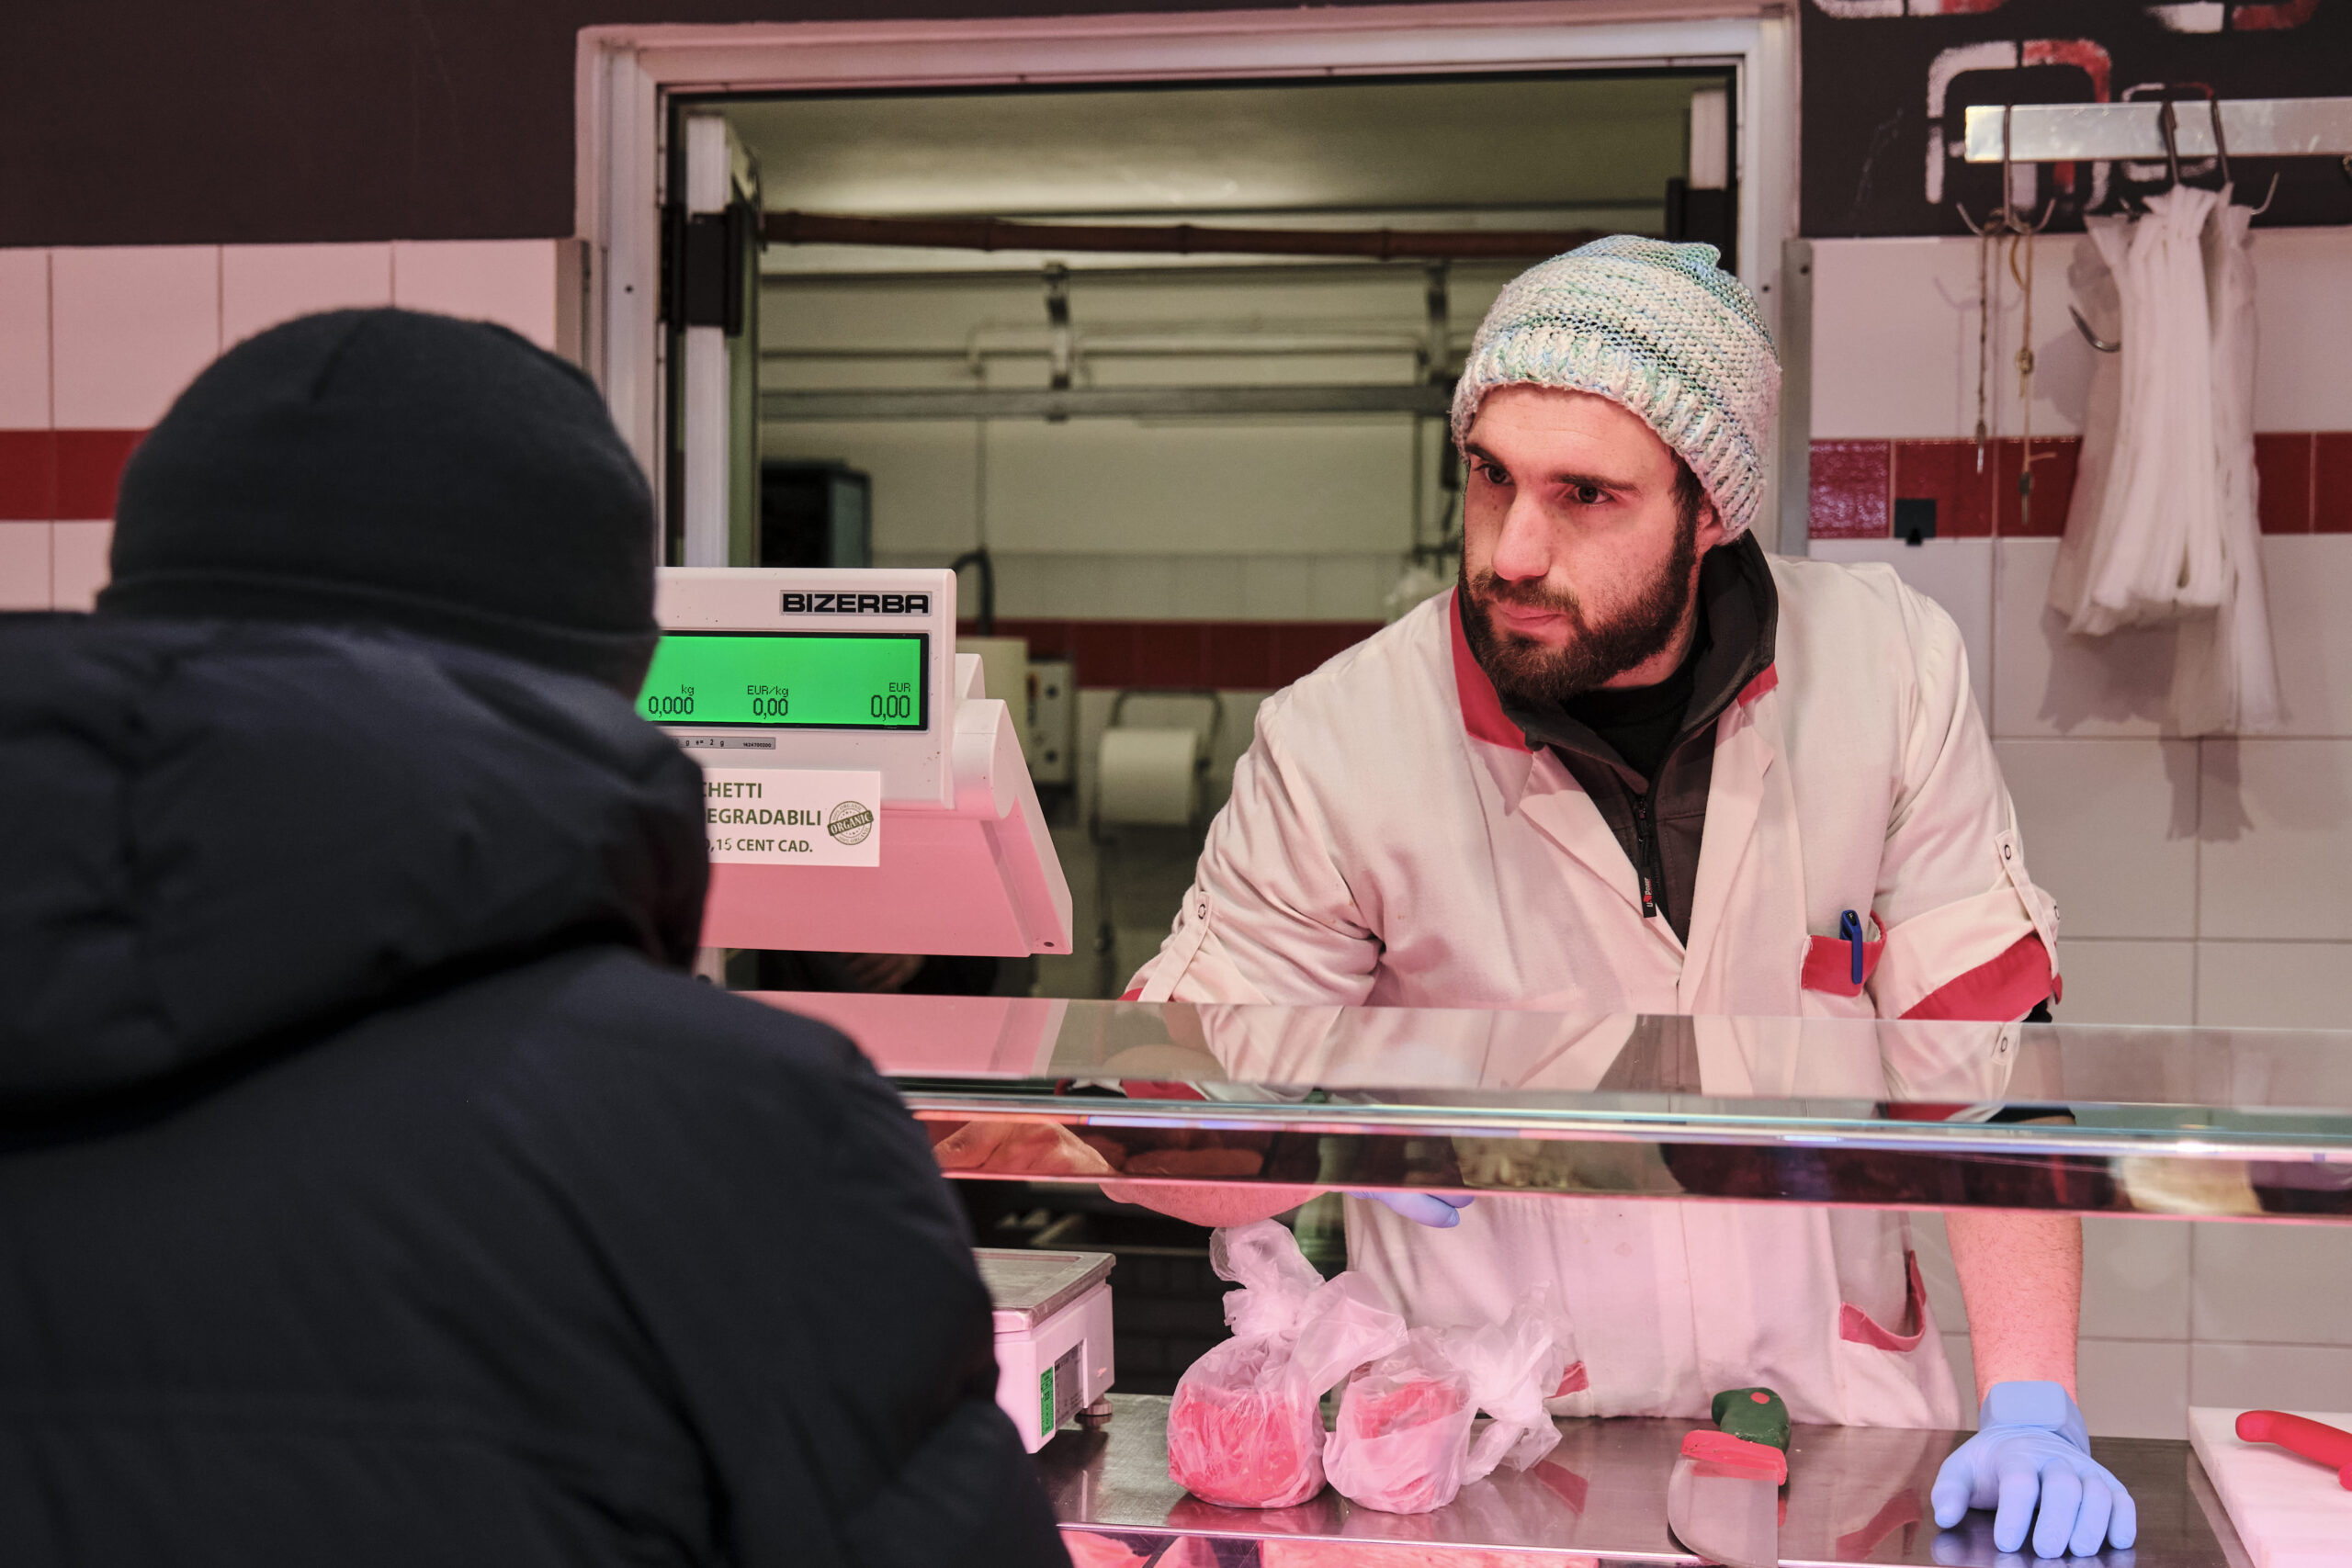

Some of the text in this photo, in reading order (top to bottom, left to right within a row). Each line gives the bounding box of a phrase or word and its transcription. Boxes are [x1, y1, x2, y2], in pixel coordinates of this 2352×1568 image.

[783, 593, 929, 614] BIZERBA
[681, 684, 695, 695] kg
[747, 685, 789, 697] EUR/kg
[888, 682, 910, 693] EUR
[648, 696, 695, 717] 0,000
[752, 698, 788, 719] 0,00
[871, 694, 910, 721] 0,00
[830, 811, 872, 834] ORGANIC
[737, 839, 775, 852] CENT
[778, 840, 812, 852] CAD.
